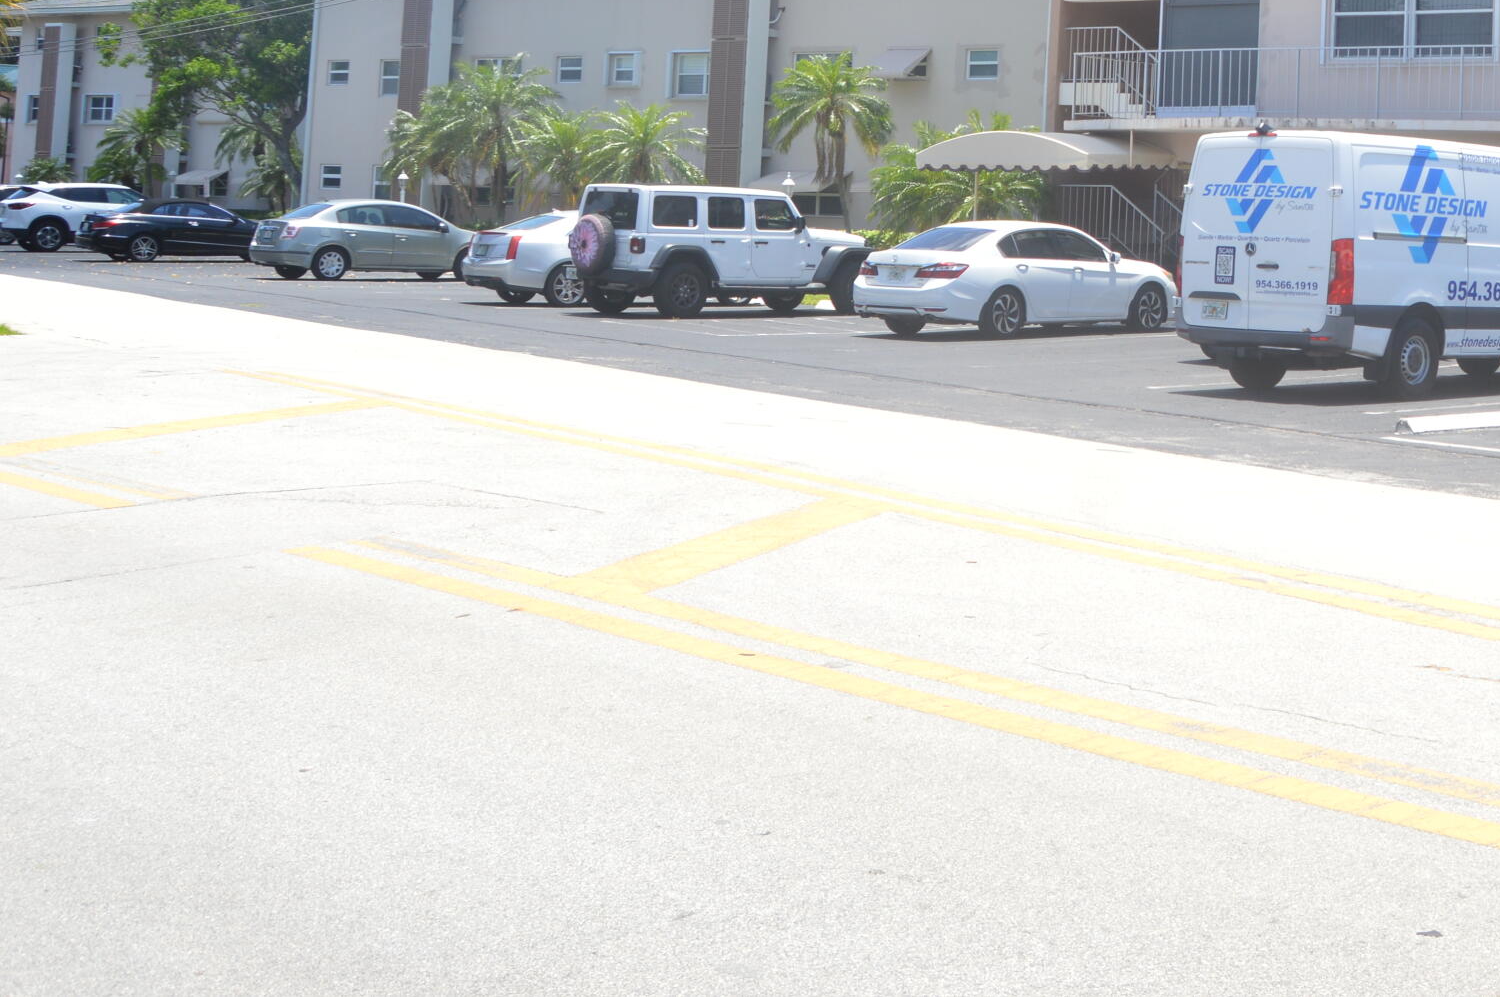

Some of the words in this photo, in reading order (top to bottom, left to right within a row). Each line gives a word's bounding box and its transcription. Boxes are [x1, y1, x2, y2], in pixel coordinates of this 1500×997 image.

[1202, 184, 1252, 197] STONE
[1254, 185, 1318, 199] DESIGN
[1360, 191, 1421, 213] STONE
[1425, 196, 1488, 218] DESIGN
[1255, 280, 1319, 290] 954.366.1919
